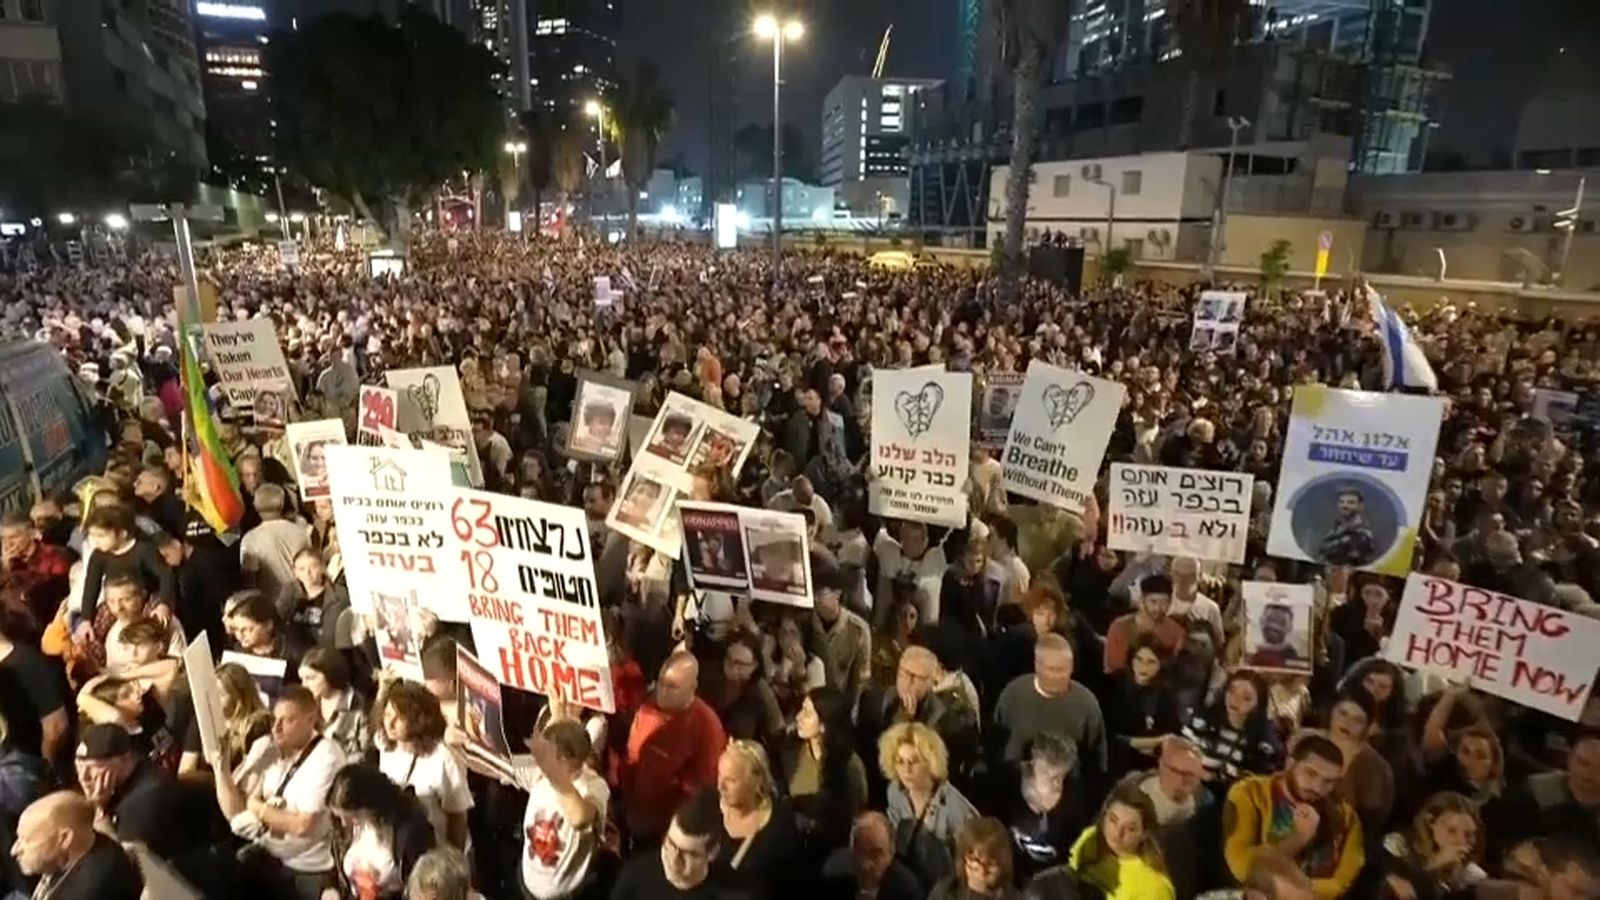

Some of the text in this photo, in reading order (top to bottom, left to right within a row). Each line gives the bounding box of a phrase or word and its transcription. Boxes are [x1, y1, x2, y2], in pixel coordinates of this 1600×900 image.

[209, 331, 256, 347] They've
[215, 351, 252, 364] Taken
[222, 366, 286, 382] Our Hearts
[879, 442, 957, 467] הלב שלנו
[1012, 429, 1067, 458] We Can't
[878, 463, 956, 487] כבר קרוע
[1006, 446, 1079, 483] Breathe
[1002, 466, 1085, 506] Without Them
[1120, 468, 1243, 495] רוצים אותם
[375, 498, 407, 509] אותם
[411, 500, 445, 511] רוצים
[1122, 488, 1243, 515] בכפר עזה
[393, 514, 424, 526] בכפר
[451, 497, 501, 548] 63
[1169, 521, 1190, 539] ב
[1199, 519, 1238, 539] ולא
[358, 529, 444, 548] לא בכפר
[368, 550, 436, 574] בעזה
[460, 550, 499, 594] 18
[468, 593, 600, 647] BRING THEM
[1415, 579, 1571, 638] BRING
[508, 627, 570, 663] BACK
[1428, 617, 1528, 658] THEM
[498, 646, 602, 708] HOME
[1406, 633, 1587, 704] HOME NOW
